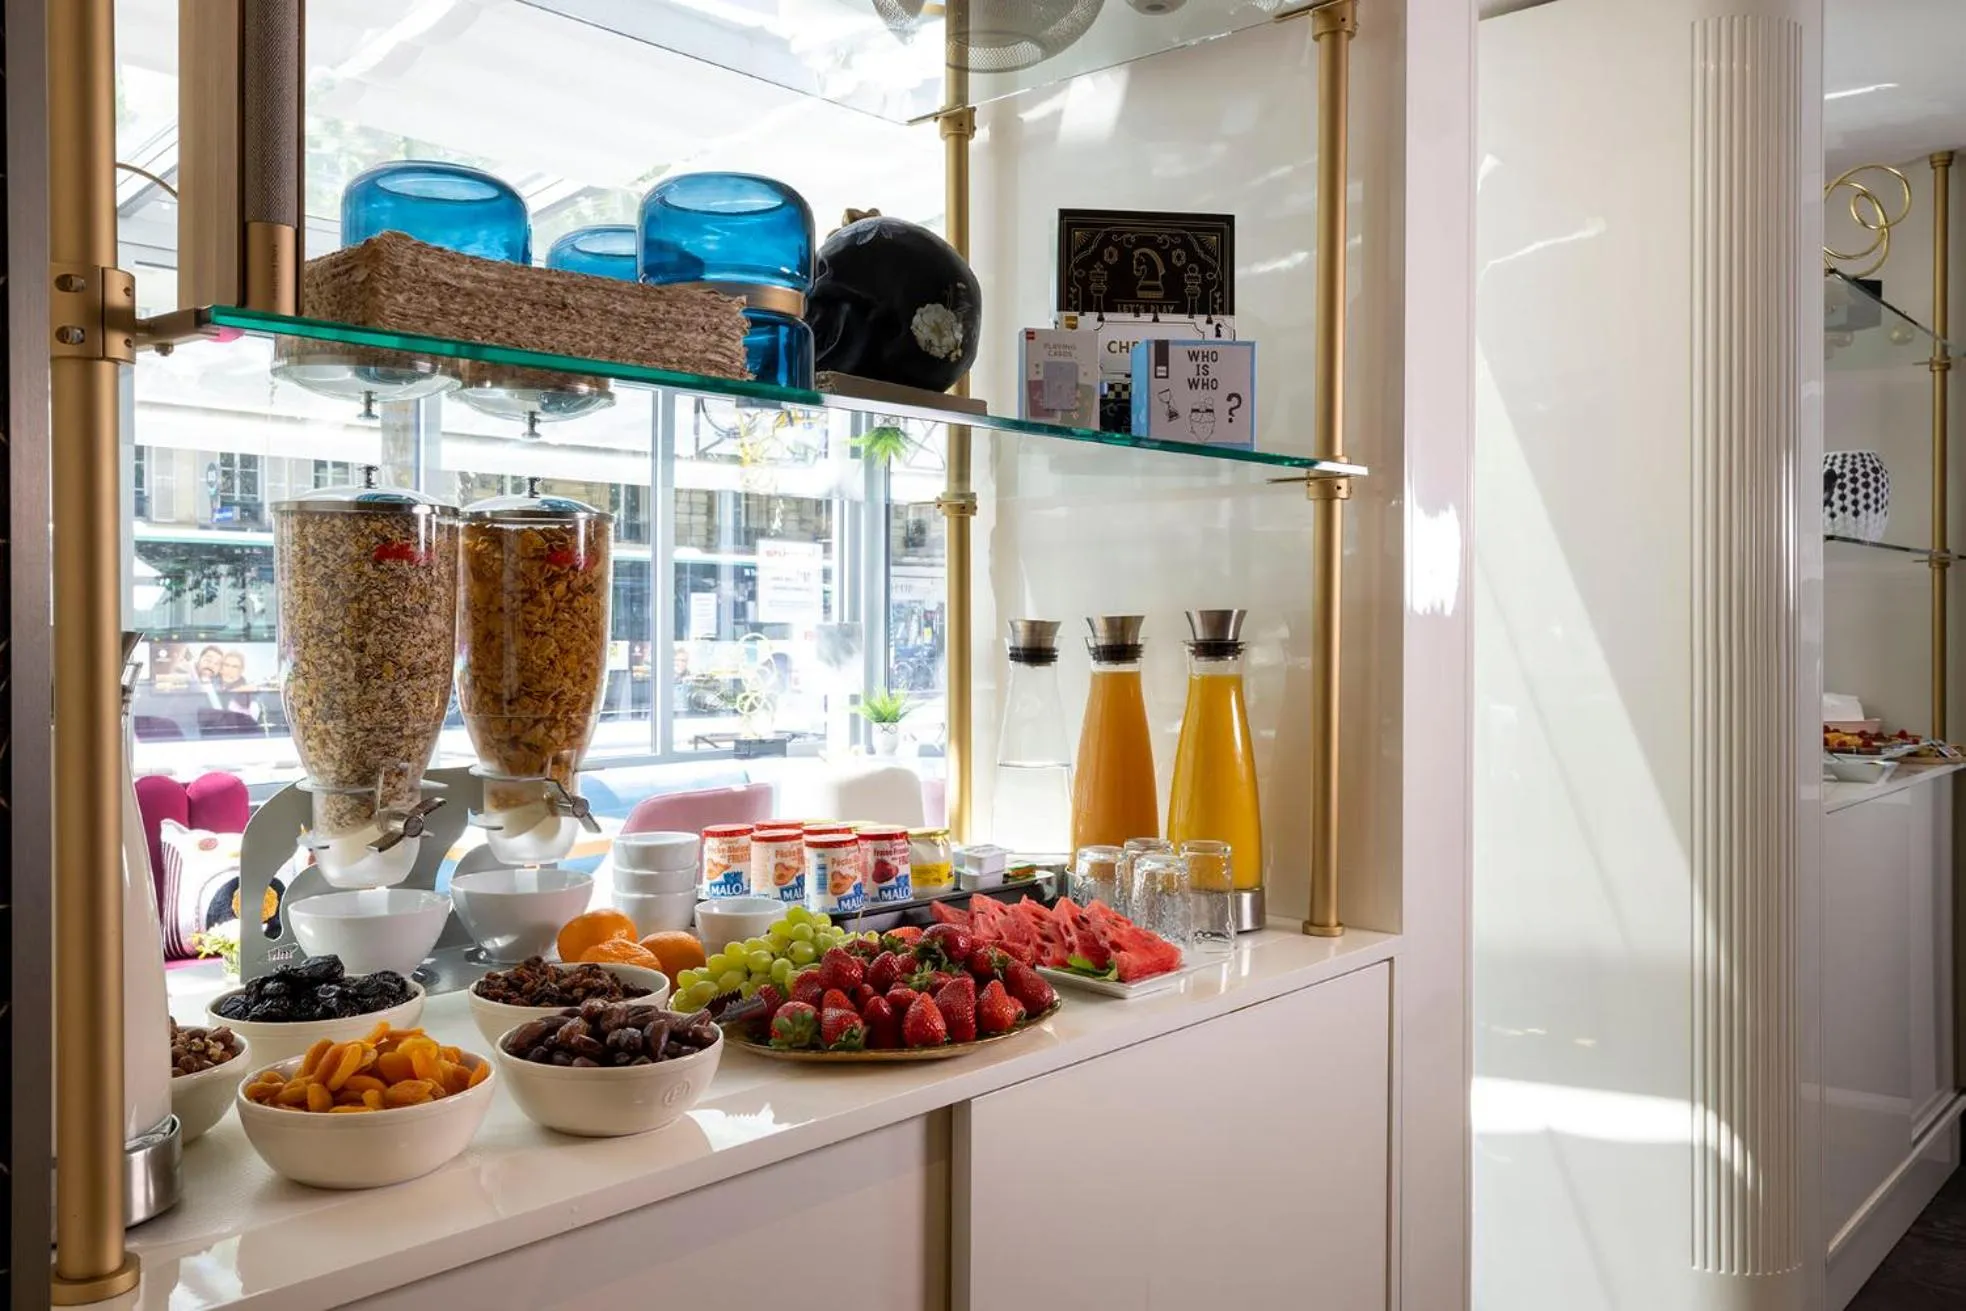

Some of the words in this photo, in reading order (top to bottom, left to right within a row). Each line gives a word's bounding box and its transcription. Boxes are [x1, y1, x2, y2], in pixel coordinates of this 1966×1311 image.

[1150, 304, 1175, 314] PLAY
[1043, 343, 1077, 351] PLAYING
[1187, 350, 1219, 363] WHO
[1196, 364, 1210, 376] IS
[1187, 378, 1219, 391] WHO
[1226, 392, 1242, 424] ?
[711, 883, 743, 896] MALO
[782, 886, 804, 901] MAL
